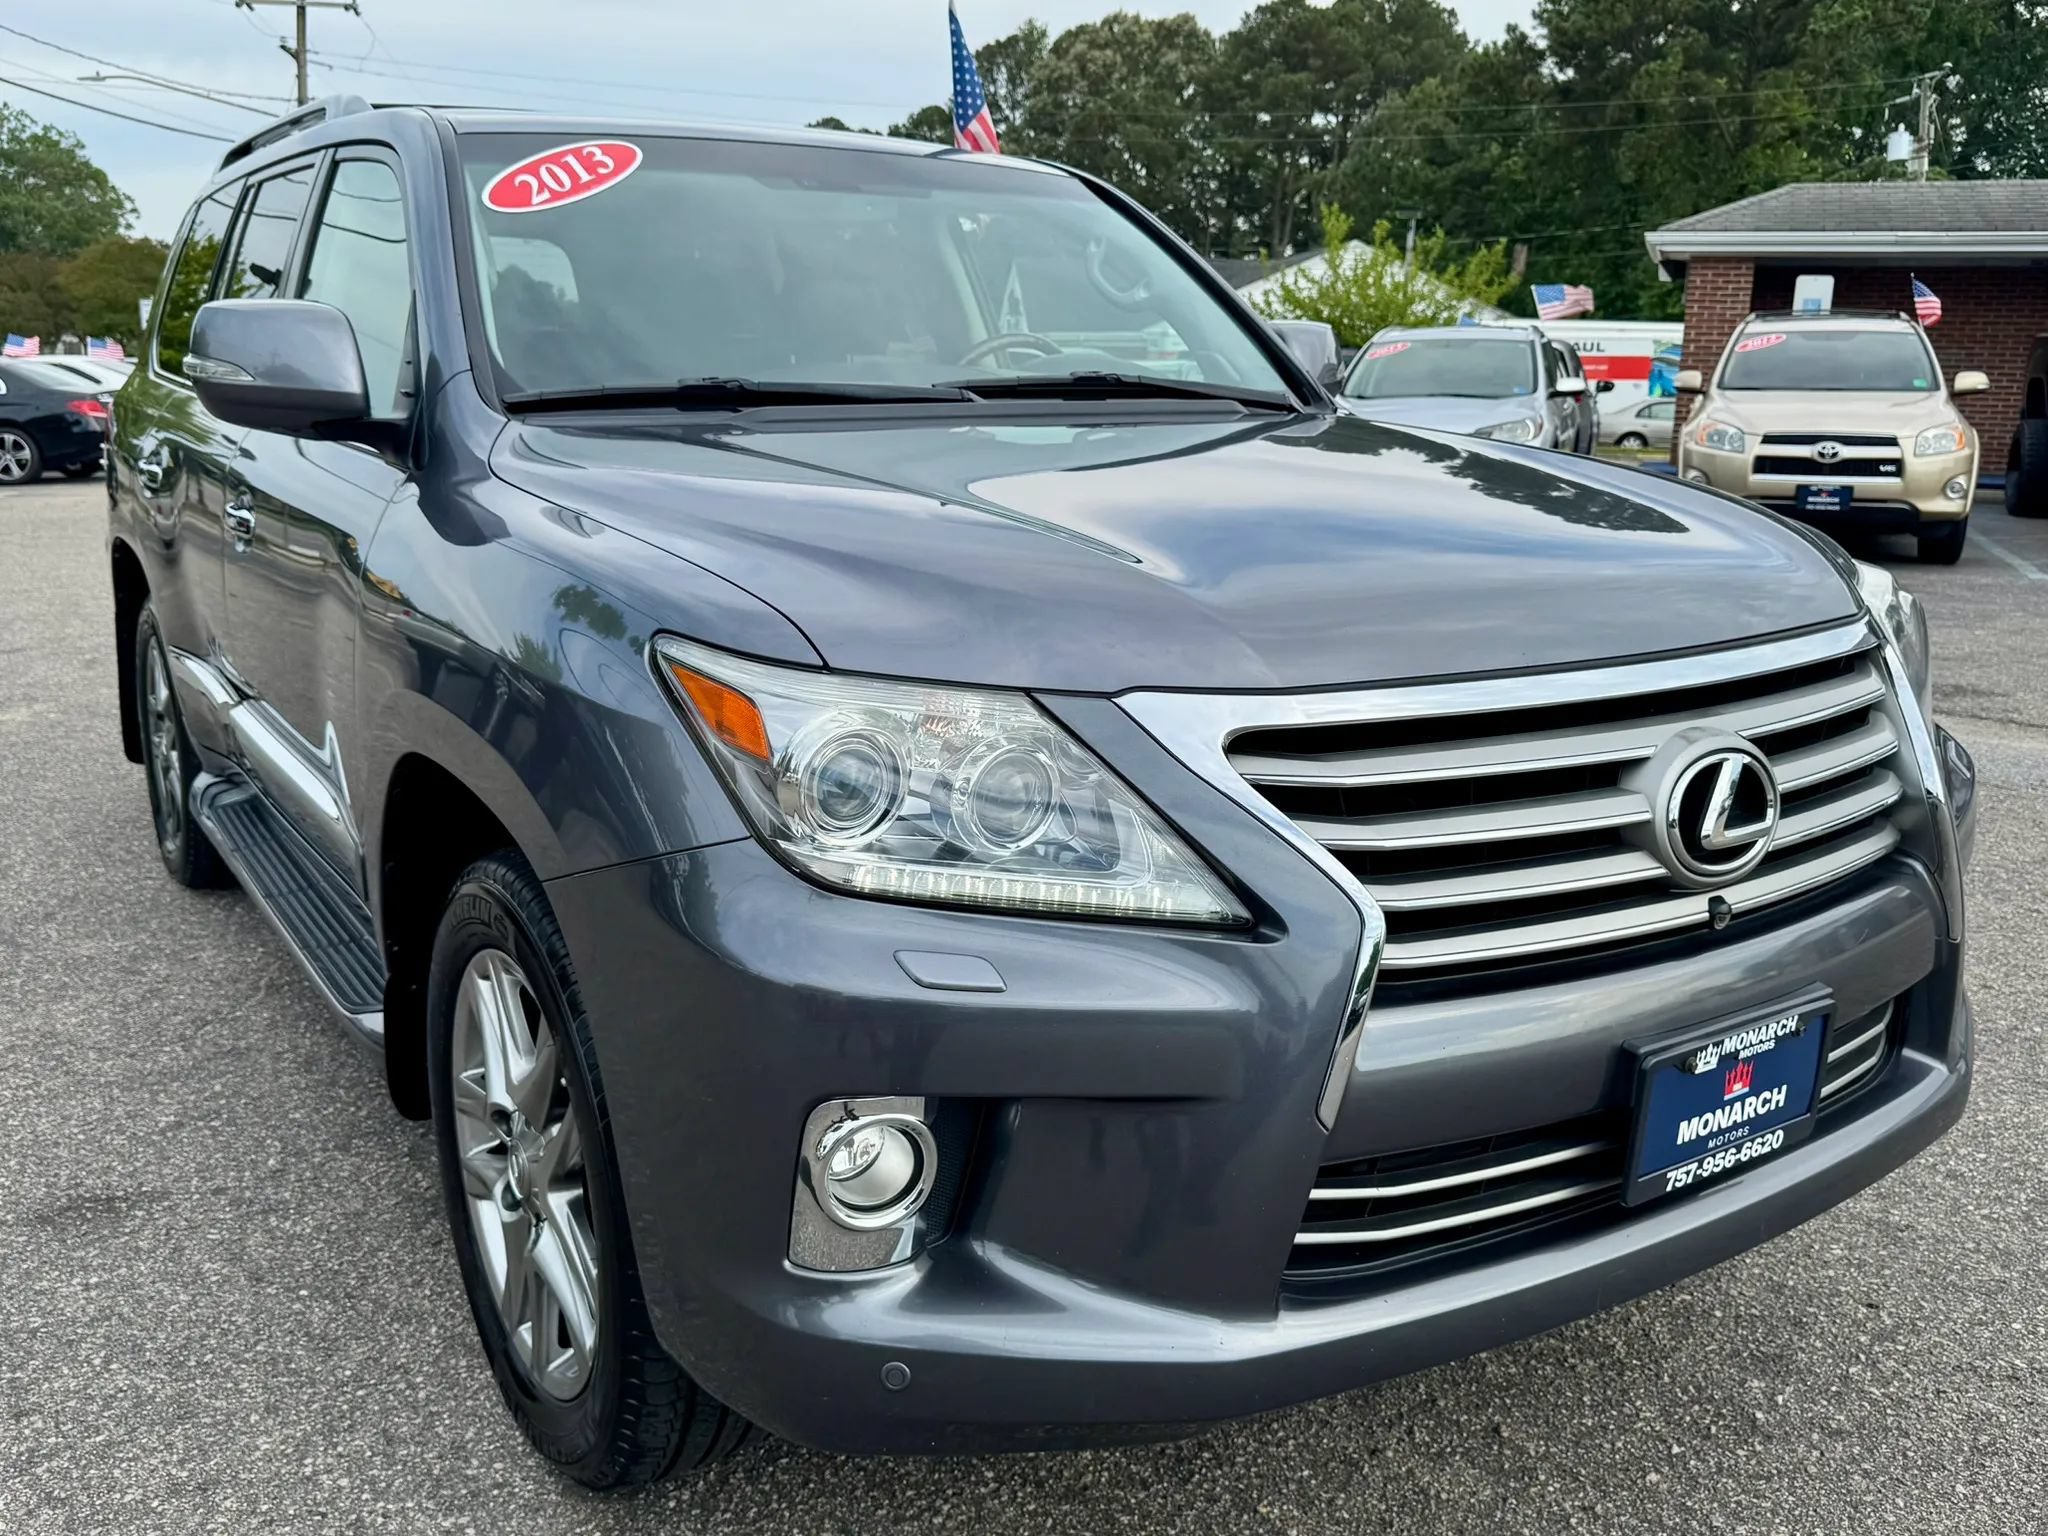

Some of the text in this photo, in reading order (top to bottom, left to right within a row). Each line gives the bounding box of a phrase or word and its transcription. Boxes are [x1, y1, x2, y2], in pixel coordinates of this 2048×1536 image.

[514, 146, 615, 206] 2013
[1721, 1014, 1799, 1056] MONARCH
[1738, 1039, 1776, 1060] MOTORS
[1676, 1084, 1787, 1145] MONARCH
[1707, 1126, 1750, 1149] MOTORS
[1665, 1129, 1784, 1192] 757-956-6620
